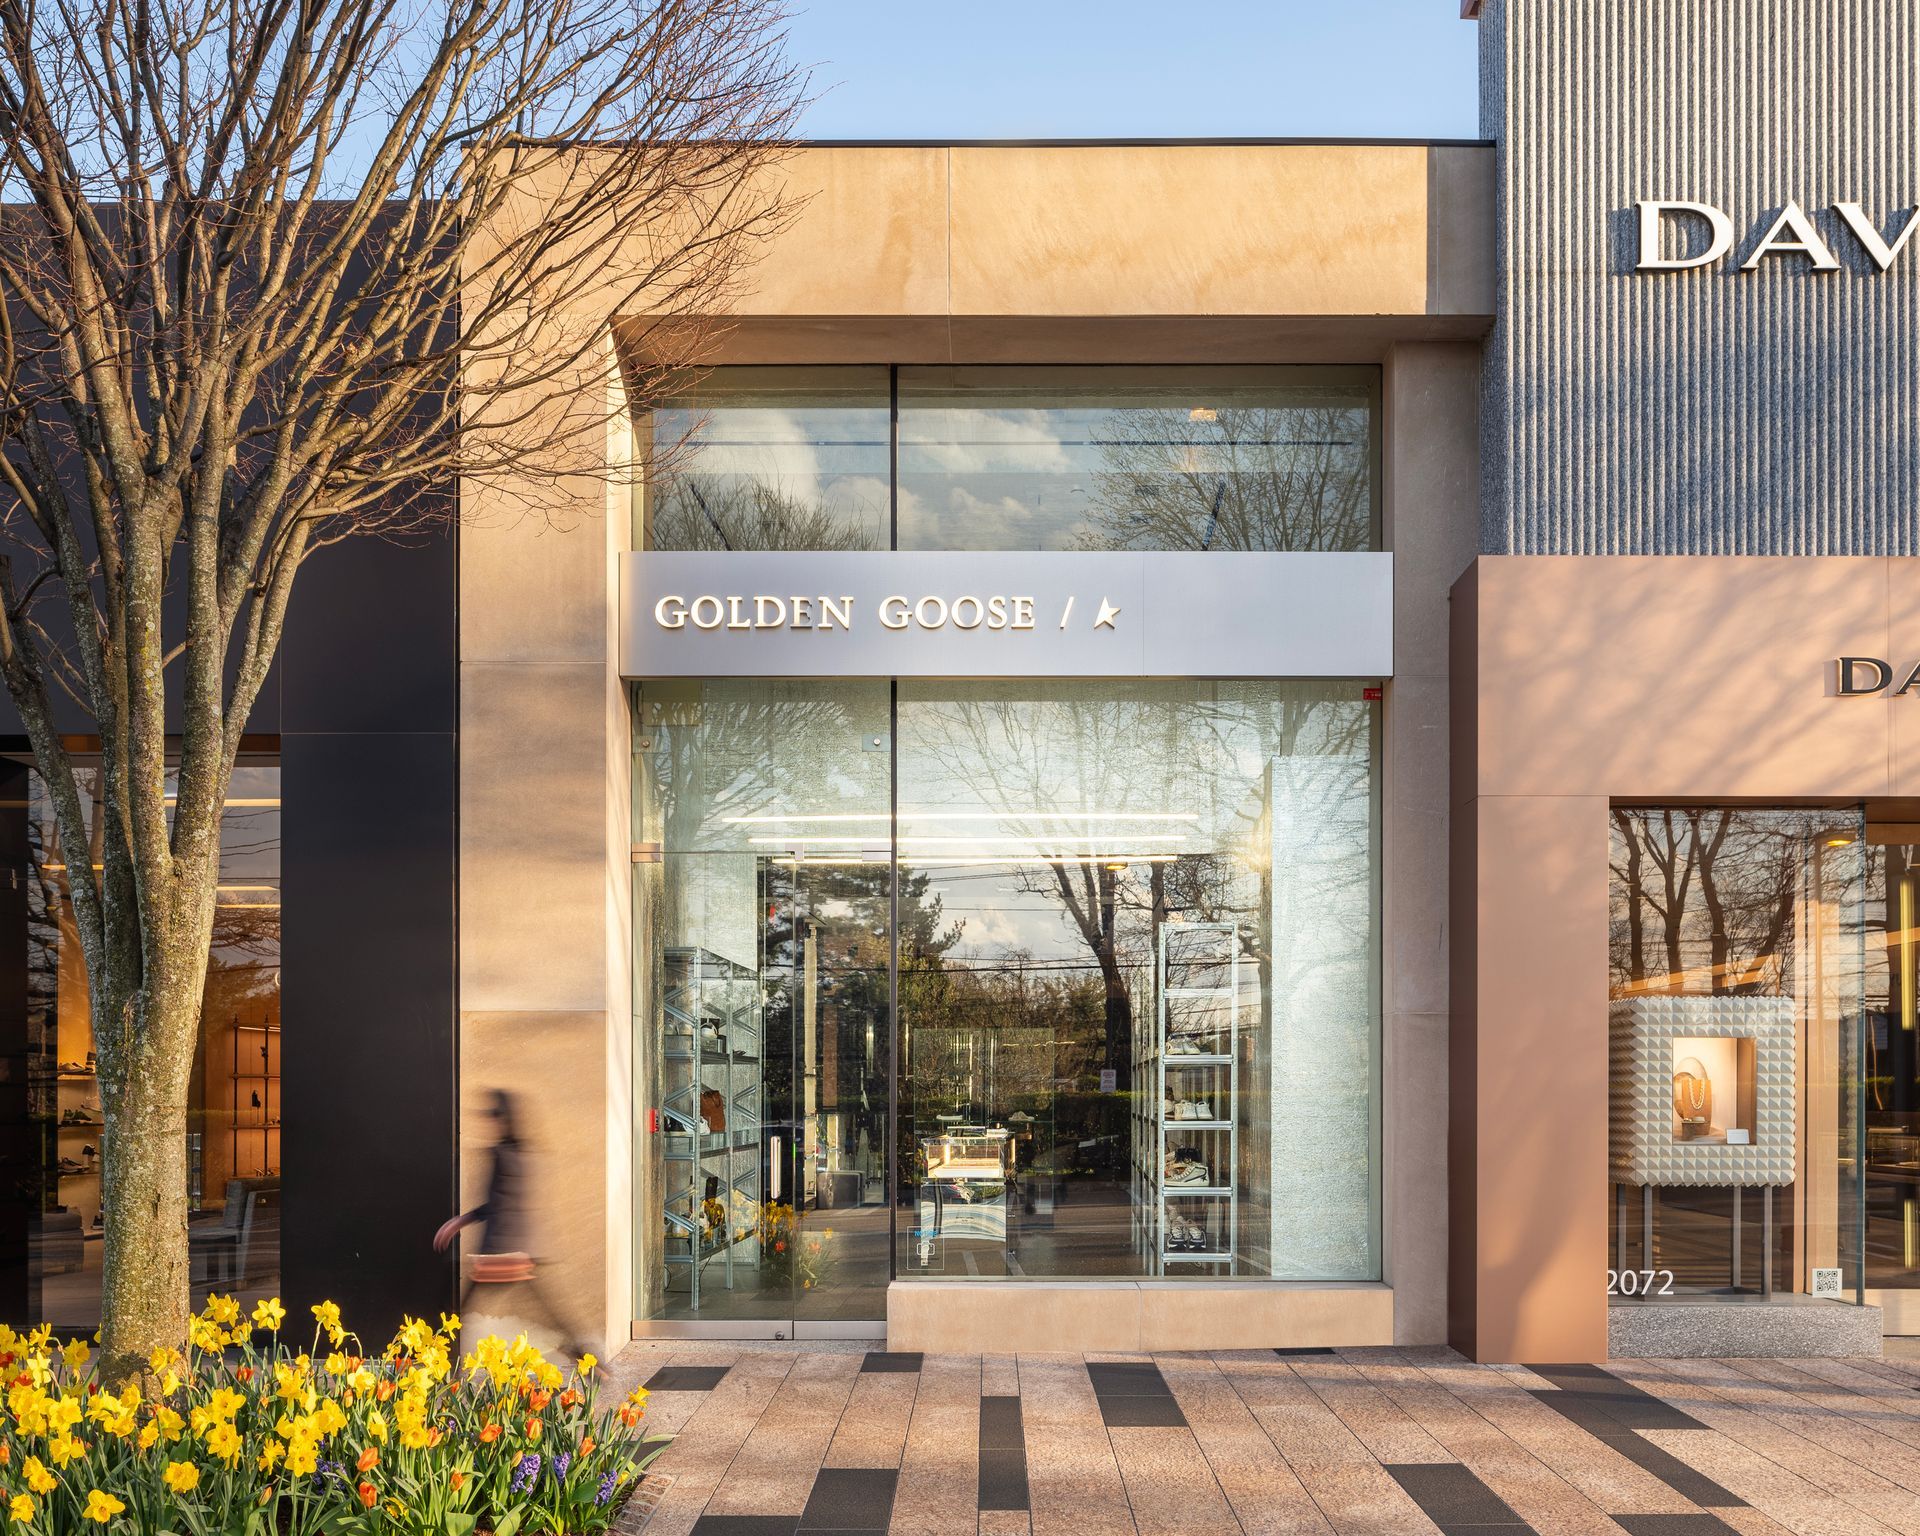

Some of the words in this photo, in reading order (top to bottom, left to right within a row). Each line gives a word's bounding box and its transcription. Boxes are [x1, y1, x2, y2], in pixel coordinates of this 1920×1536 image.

[1635, 200, 1920, 272] DAV
[654, 595, 854, 629] GOLDEN
[879, 595, 1035, 629] GOOSE
[1608, 1269, 1674, 1295] 2072
